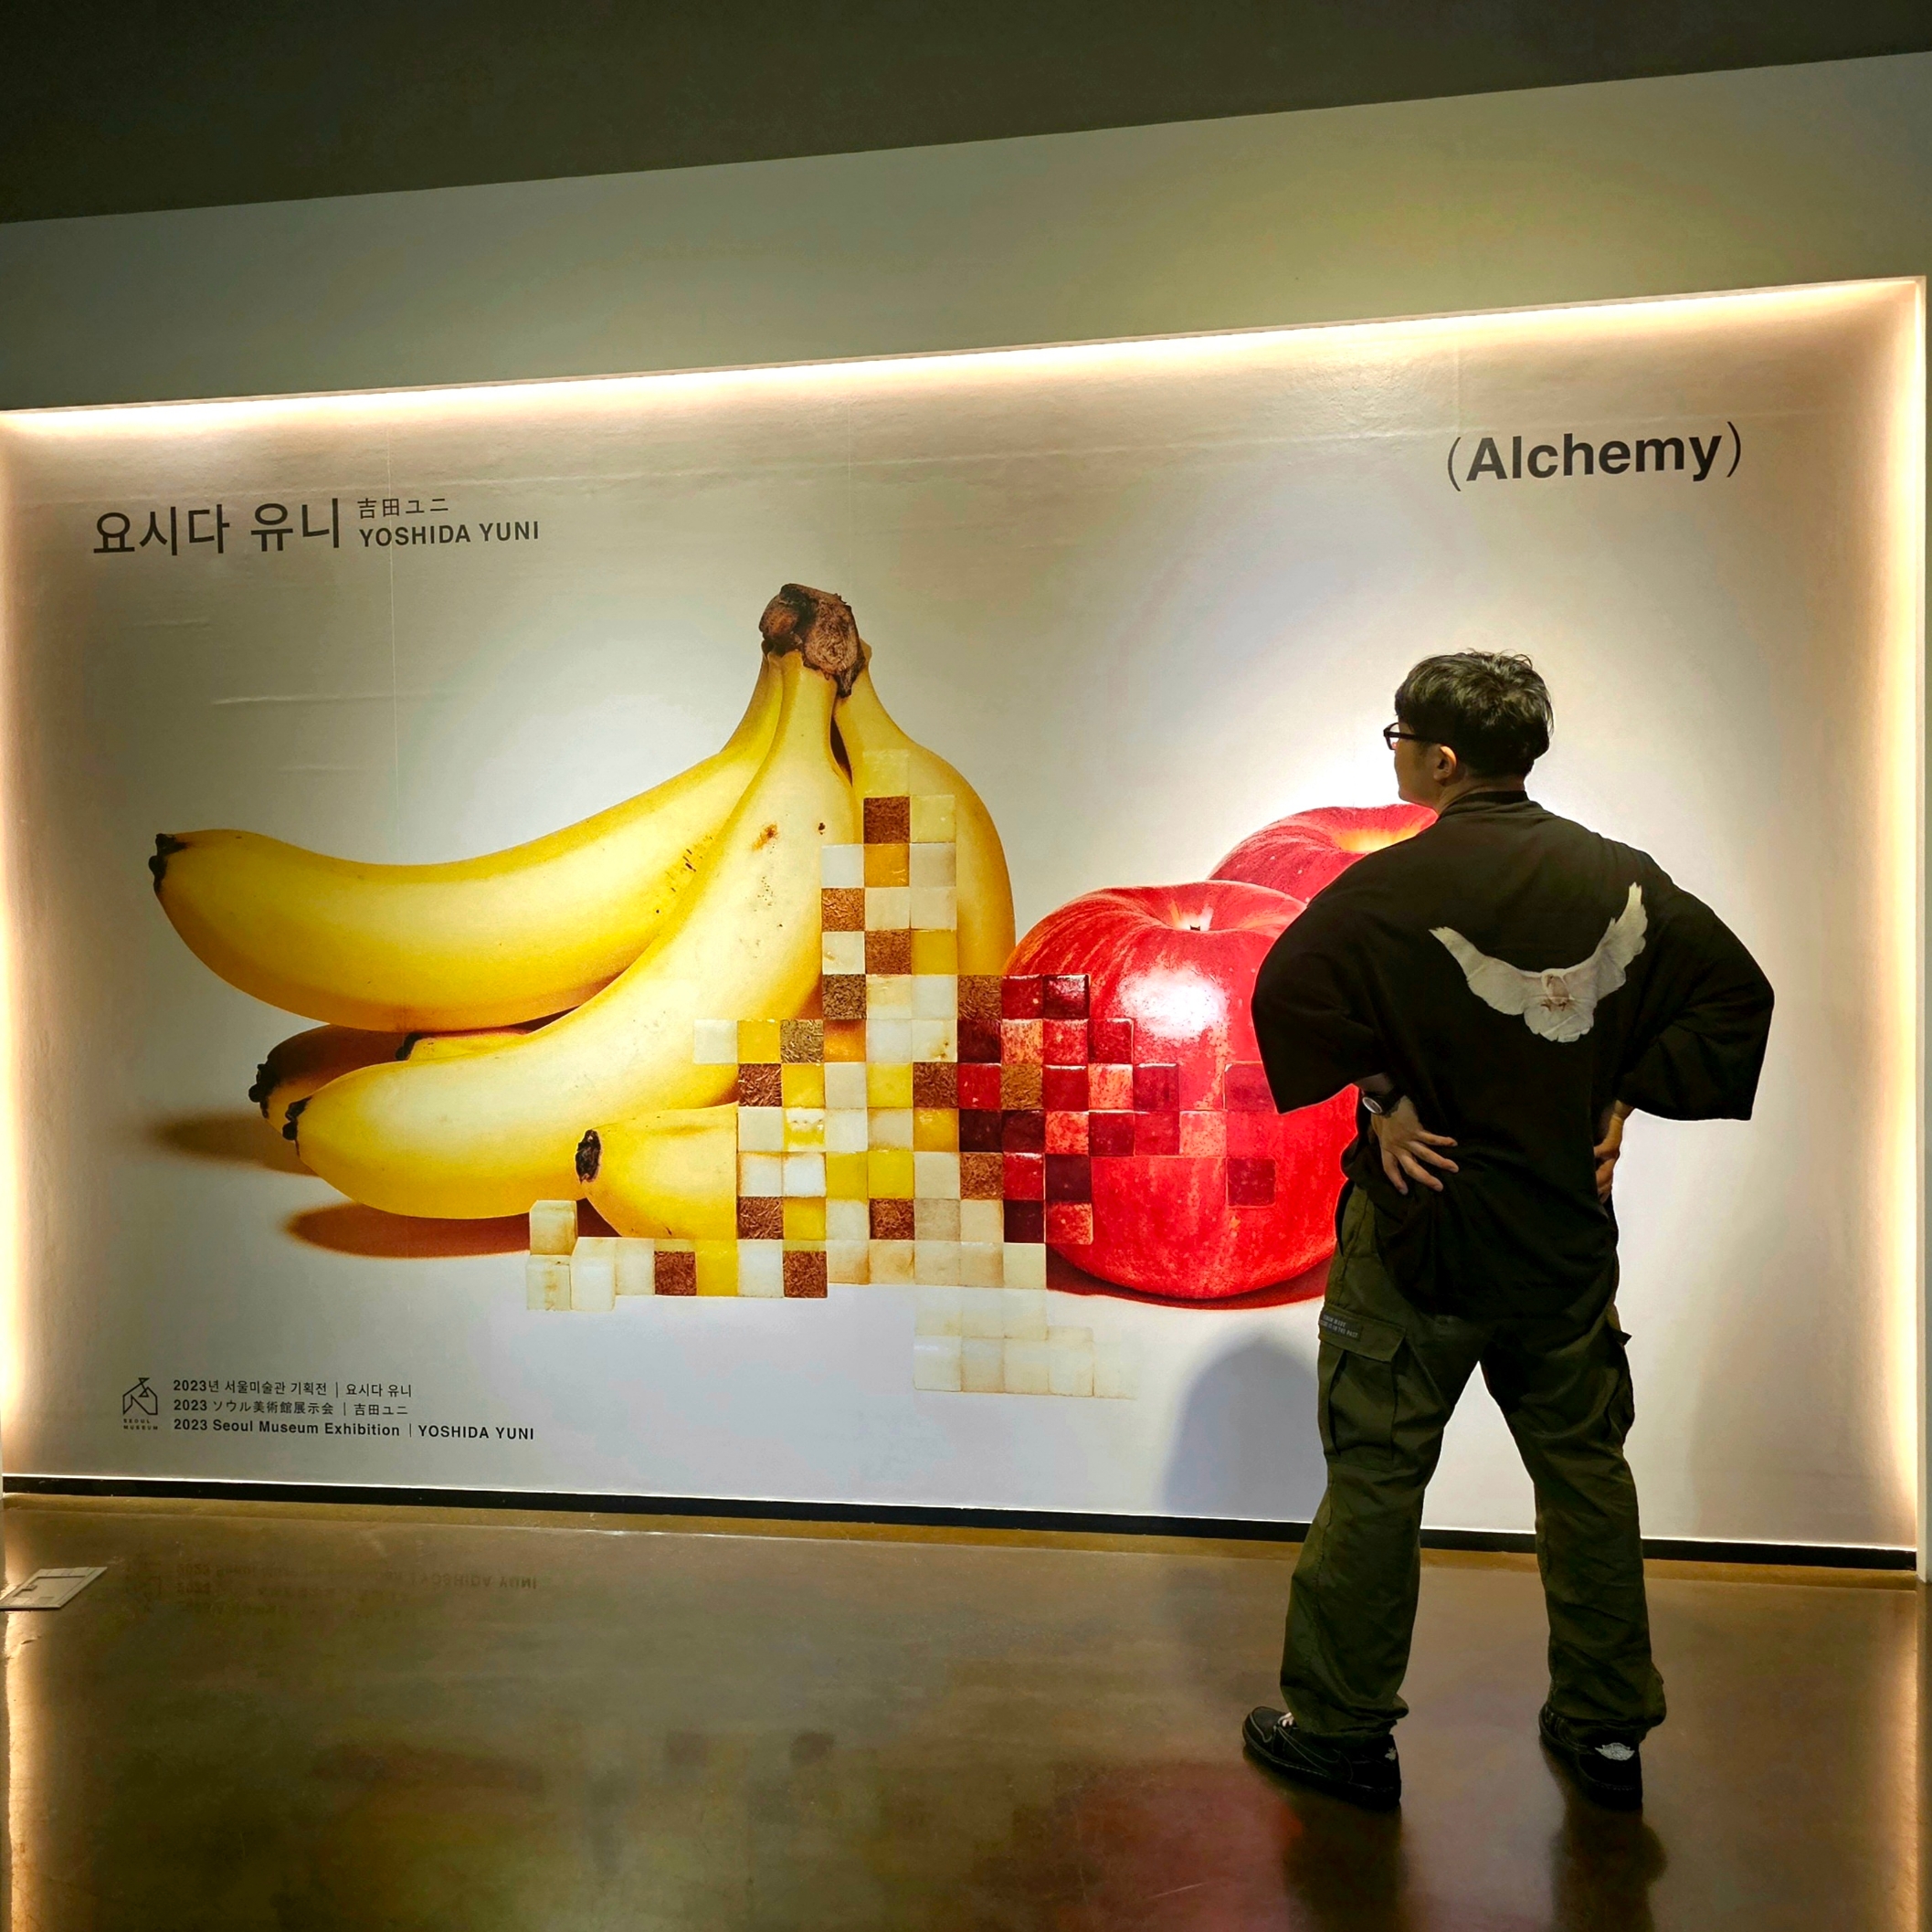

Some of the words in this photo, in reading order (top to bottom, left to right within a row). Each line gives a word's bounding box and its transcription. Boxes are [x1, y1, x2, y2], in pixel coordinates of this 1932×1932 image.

[1448, 421, 1741, 491] (Alchemy)
[357, 498, 449, 519] 吉田ユニ
[94, 504, 229, 555] 요시다
[251, 498, 339, 552] 유니
[359, 524, 470, 547] YOSHIDA
[479, 522, 538, 541] YUNI
[174, 1380, 218, 1392] 2023년
[225, 1380, 285, 1394] 서울미술관
[291, 1382, 326, 1396] 기획전
[346, 1384, 383, 1397] 요시다
[388, 1385, 411, 1398] 유니
[174, 1399, 207, 1410] 2023
[354, 1403, 407, 1415] 吉田ユニ
[174, 1419, 207, 1431] 2023
[213, 1420, 252, 1431] Seoul
[259, 1420, 318, 1433] Museum
[325, 1423, 399, 1436] Exhibition
[418, 1425, 489, 1438] YOSHIDA
[496, 1427, 533, 1440] YUNI
